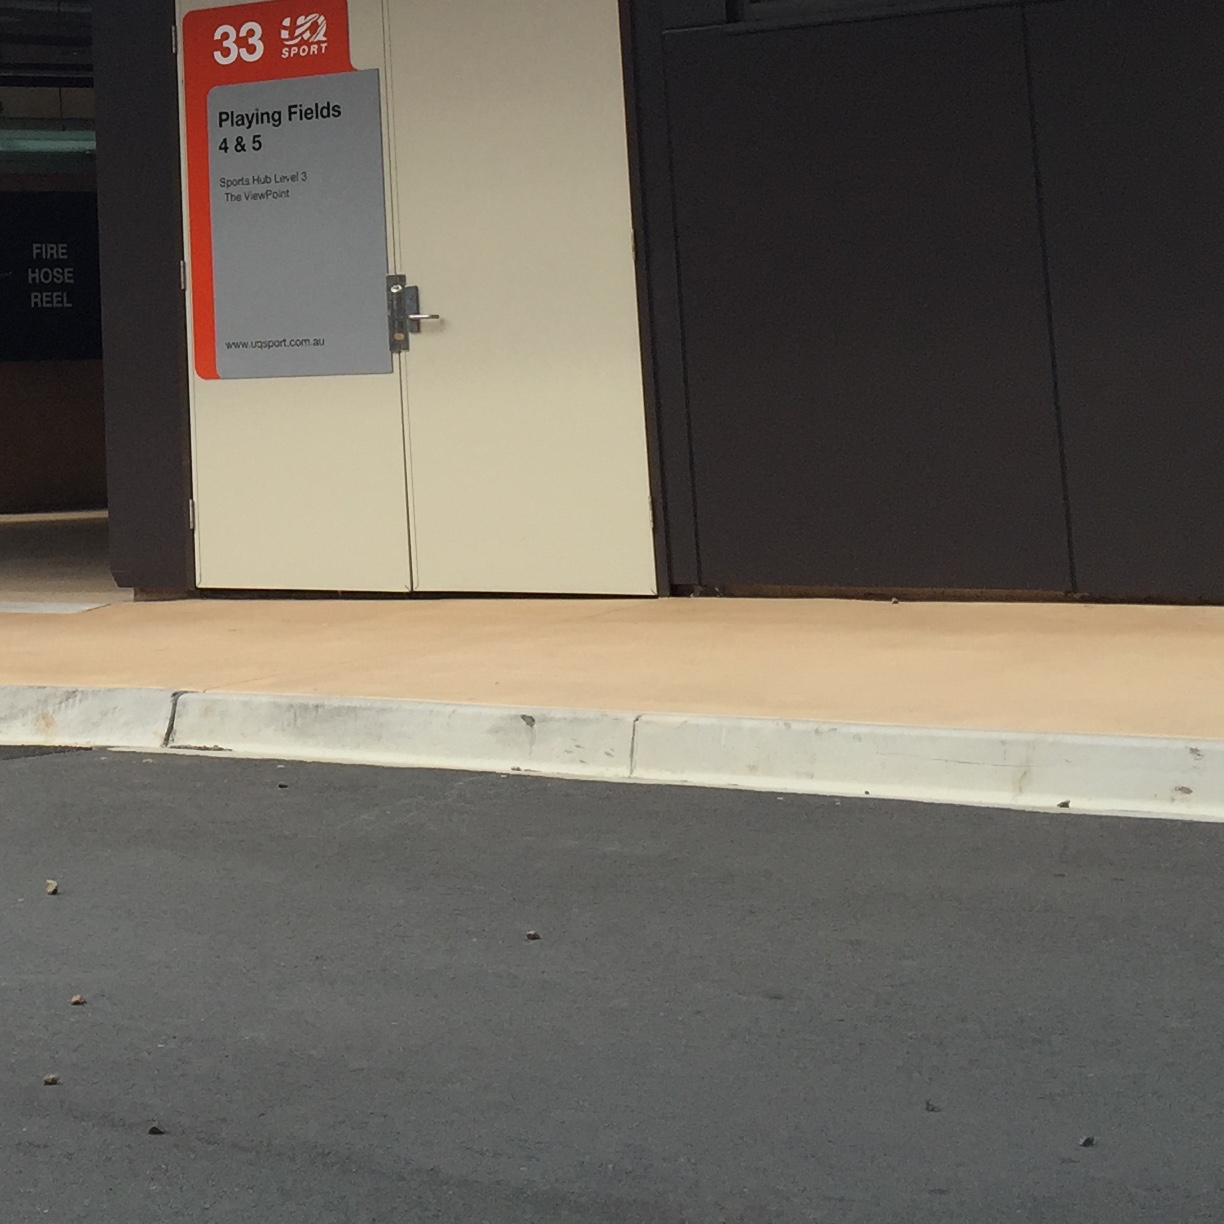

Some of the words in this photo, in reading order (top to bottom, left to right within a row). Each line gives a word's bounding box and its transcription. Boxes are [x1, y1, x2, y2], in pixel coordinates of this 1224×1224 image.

[213, 21, 264, 65] 33
[281, 43, 328, 59] SPORT
[218, 108, 282, 129] Playing
[288, 101, 342, 122] Fields
[219, 138, 229, 153] 4
[234, 136, 246, 153] &
[252, 135, 262, 151] 5
[219, 177, 250, 189] Sports
[252, 175, 272, 185] Hub
[274, 171, 299, 183] Level
[301, 171, 308, 182] 3
[225, 192, 242, 202] The
[244, 189, 290, 201] ViewPoint
[32, 243, 68, 260] FIRE
[28, 268, 74, 284] HOSE
[30, 292, 73, 308] REEL
[225, 338, 325, 349] www.uqsport.com.au
